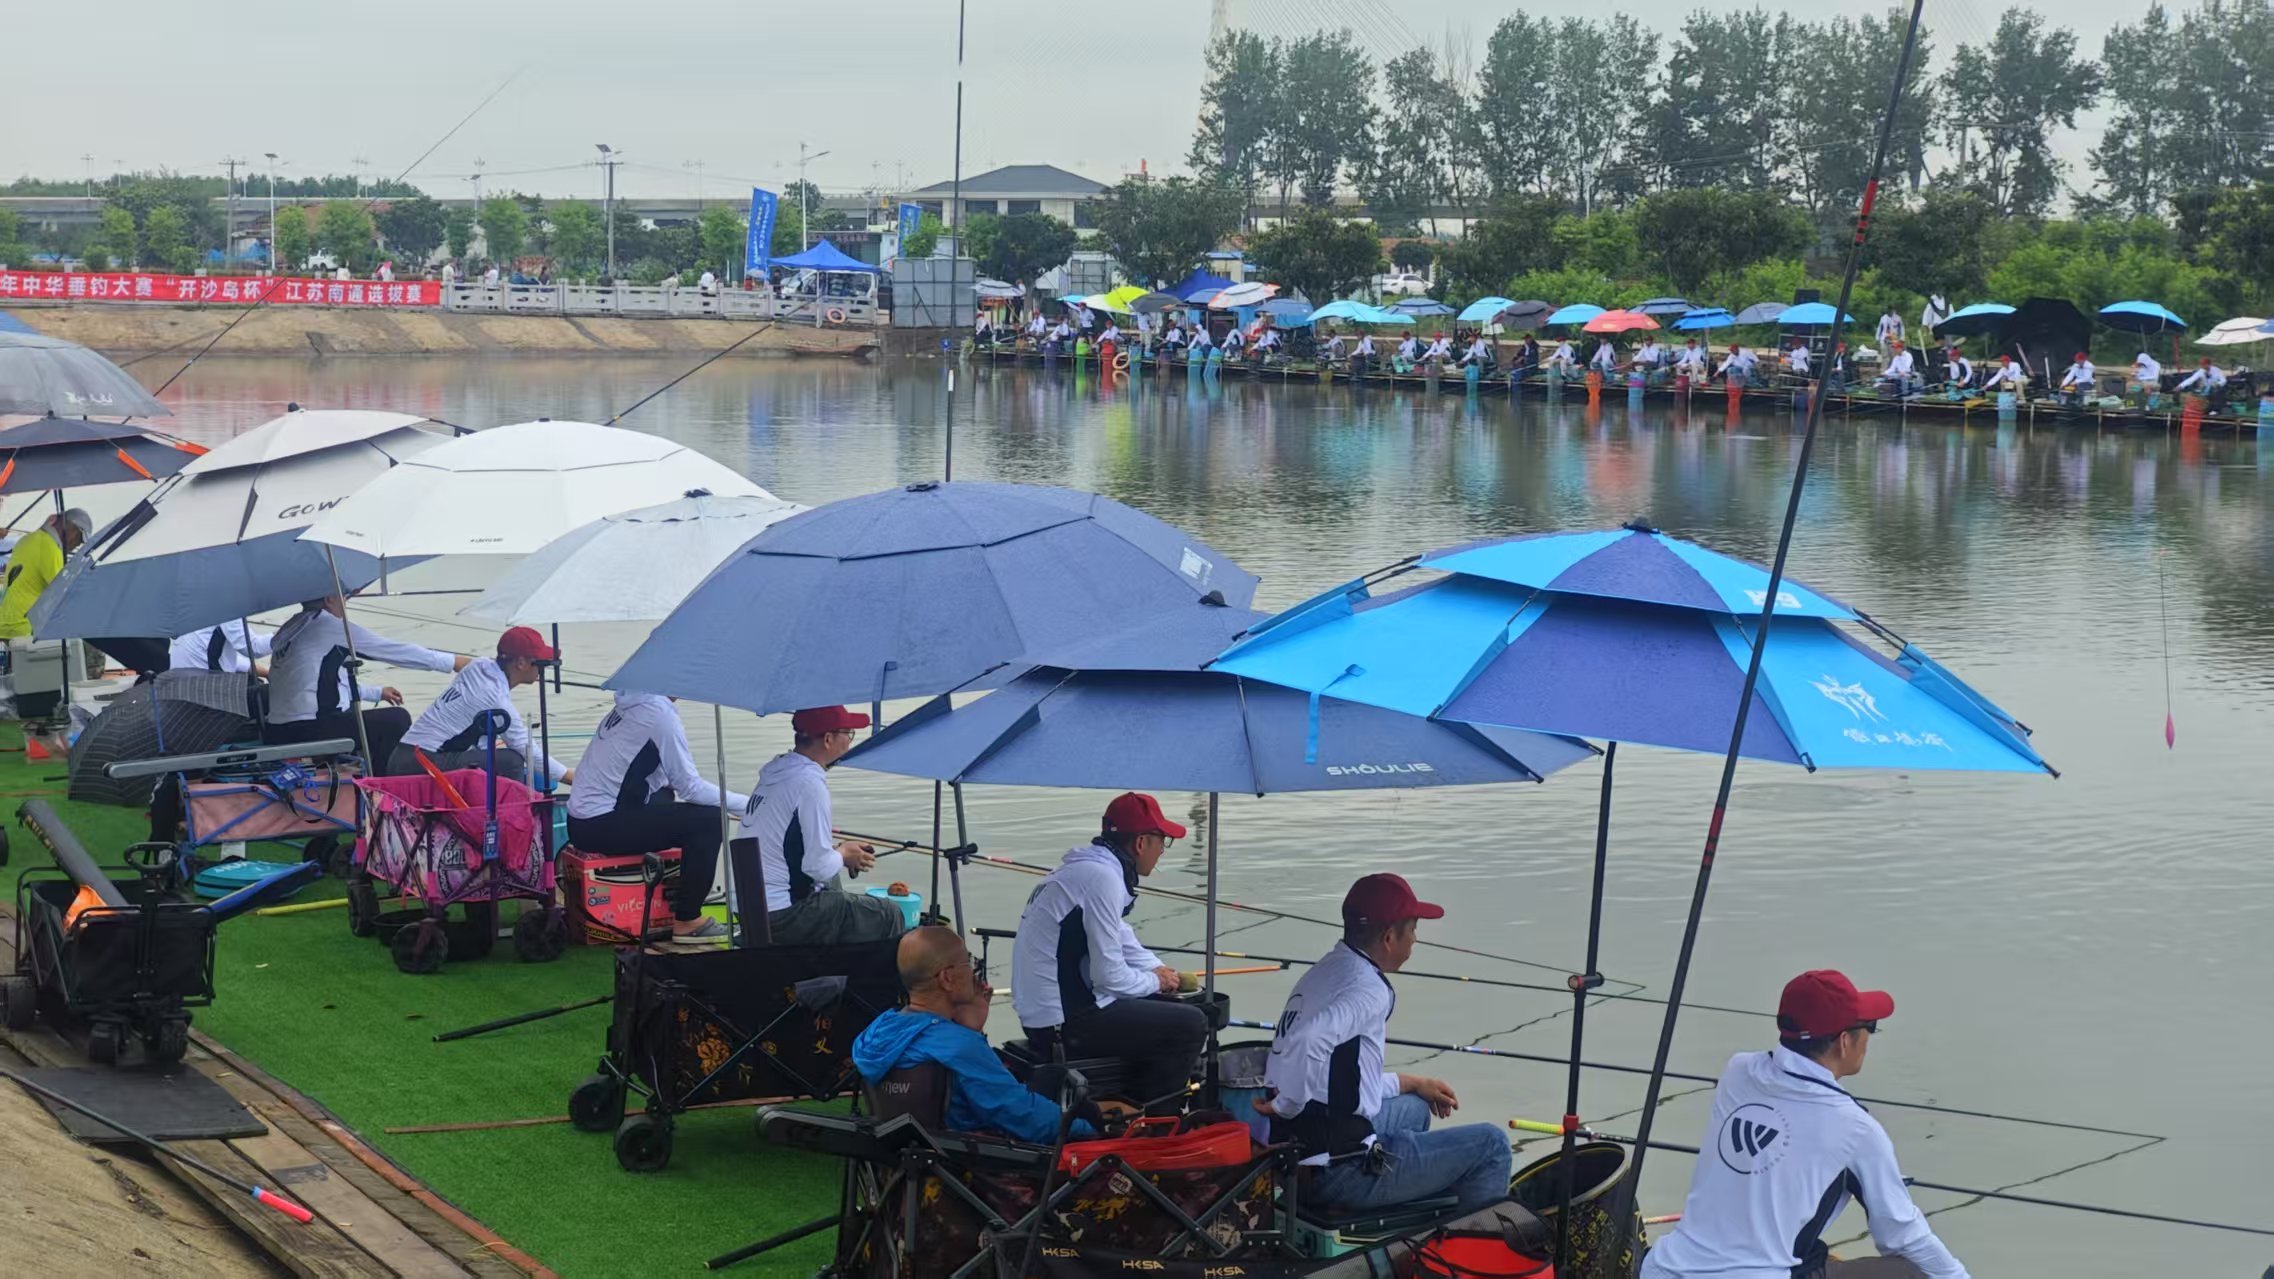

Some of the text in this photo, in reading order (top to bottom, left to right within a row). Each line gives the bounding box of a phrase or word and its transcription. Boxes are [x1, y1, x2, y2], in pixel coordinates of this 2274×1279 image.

[286, 281, 422, 304] 江苏南通选拔赛
